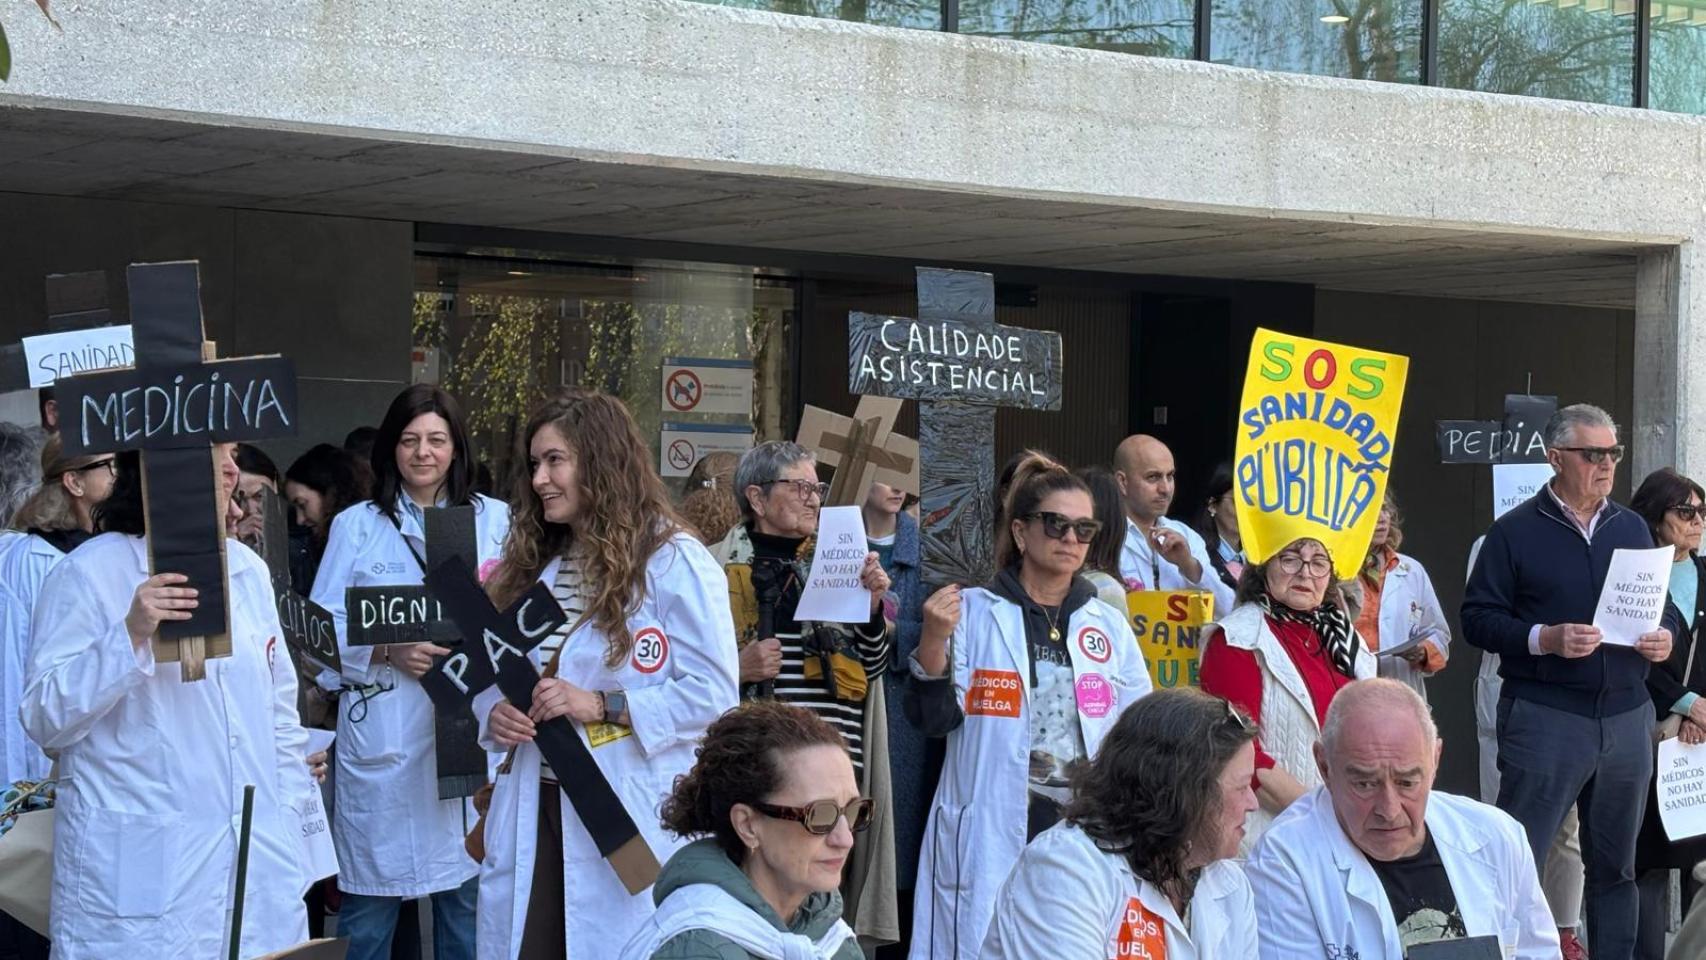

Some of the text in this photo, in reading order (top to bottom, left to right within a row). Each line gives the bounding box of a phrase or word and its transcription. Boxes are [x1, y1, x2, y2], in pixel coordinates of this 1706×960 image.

[1260, 341, 1387, 400] SOS
[1242, 392, 1390, 462] SANIDAD
[1237, 439, 1388, 531] PÚBLICA
[1517, 485, 1535, 495] SIN
[838, 532, 853, 544] SIN
[820, 547, 865, 560] MÉDICOS
[821, 563, 860, 575] NO HAY
[811, 578, 859, 589] SANIDAD
[1635, 572, 1655, 582] SIN
[1614, 582, 1663, 594] MÉDICOS
[1616, 595, 1658, 608] NO HAY
[1605, 605, 1657, 620] SANIDAD
[441, 598, 553, 695] PAC
[638, 638, 661, 660] 30
[1085, 635, 1106, 653] 30
[1081, 680, 1103, 691] STOP
[1673, 756, 1689, 769] SIN
[1661, 767, 1705, 784] MÉDICOS
[1667, 781, 1704, 796] NO HAY
